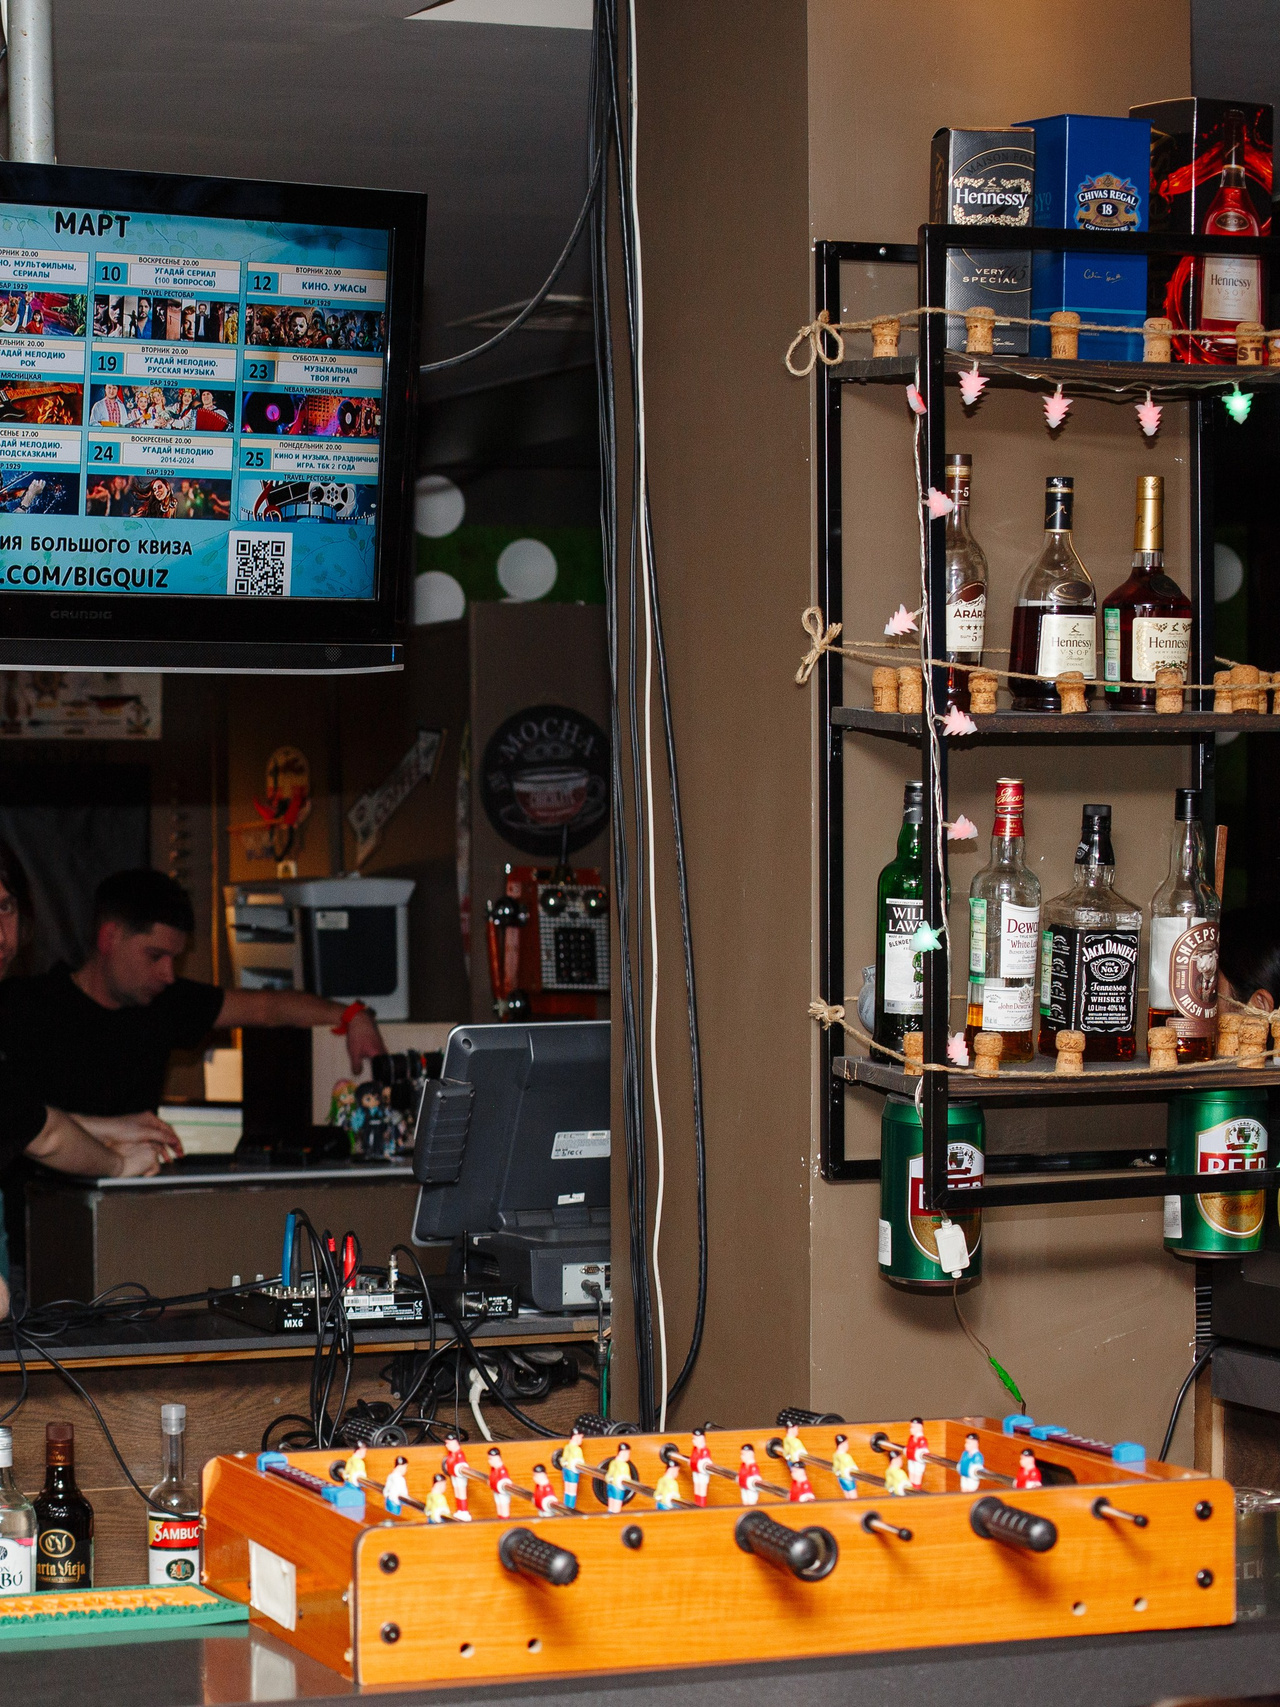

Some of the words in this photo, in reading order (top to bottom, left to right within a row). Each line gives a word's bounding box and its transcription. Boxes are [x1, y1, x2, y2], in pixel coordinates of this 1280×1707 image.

[956, 189, 1028, 208] Hennessy
[1079, 190, 1108, 202] CHIVAS
[1110, 190, 1136, 205] REGAL
[1102, 204, 1112, 215] 18
[55, 211, 131, 238] МАРТ
[14, 260, 76, 271] МУЛЬТФИЛЬМЫ,
[139, 257, 180, 265] ВОСКРЕСЕНЬЕ
[13, 270, 50, 278] СЕРИАЛЫ
[102, 266, 120, 281] 10
[155, 267, 184, 276] УГАДАЙ
[187, 269, 216, 277] СЕРИАЛ
[173, 278, 216, 287] ВОПРОСОВ)
[254, 276, 271, 290] 12
[1211, 273, 1252, 290] Hennessy
[302, 282, 330, 291] КИНО.
[333, 284, 366, 293] УЖАСЫ
[164, 291, 194, 299] РЕСТОБАР
[25, 351, 65, 360] МЕЛОДИЮ
[98, 356, 116, 371] 19
[177, 359, 218, 367] МЕЛОДИЮ.
[184, 368, 215, 376] МУЗЫКА
[250, 364, 267, 379] 23
[304, 365, 358, 374] МУЗЫКАЛЬНАЯ
[1, 372, 42, 380] МЯСНИЦКАЯ
[20, 441, 62, 449] МЕЛОДИЮ.
[131, 436, 172, 444] ВОСКРЕСЕНЬЕ
[142, 446, 171, 454] УГАДАЙ
[175, 448, 213, 456] МЕЛОДИЮ
[280, 442, 324, 450] ПОНЕДЕЛЬНИК
[0, 449, 57, 458] ПОДСКАЗКАМИ
[94, 446, 113, 461] 24
[333, 455, 378, 463] ПРАЗДНИЧНАЯ
[161, 456, 194, 464] 2014-2024
[246, 452, 263, 467] 25
[30, 536, 131, 555] БОЛЬШОГО
[138, 539, 192, 557] КВИЗА
[50, 609, 112, 620] GRUNDIG
[972, 632, 978, 642] 5
[1052, 637, 1092, 649] Hennessy
[1176, 926, 1215, 964] SHEEP'S
[1082, 943, 1105, 962] JACK
[1106, 939, 1137, 964] DANIEL'S
[1091, 982, 1127, 991] Tennessee
[1179, 994, 1202, 1017] IRISH
[284, 1319, 303, 1328] MX6
[154, 1523, 199, 1542] SAMBUC
[37, 1563, 55, 1576] arta
[57, 1560, 85, 1582] Vieja
